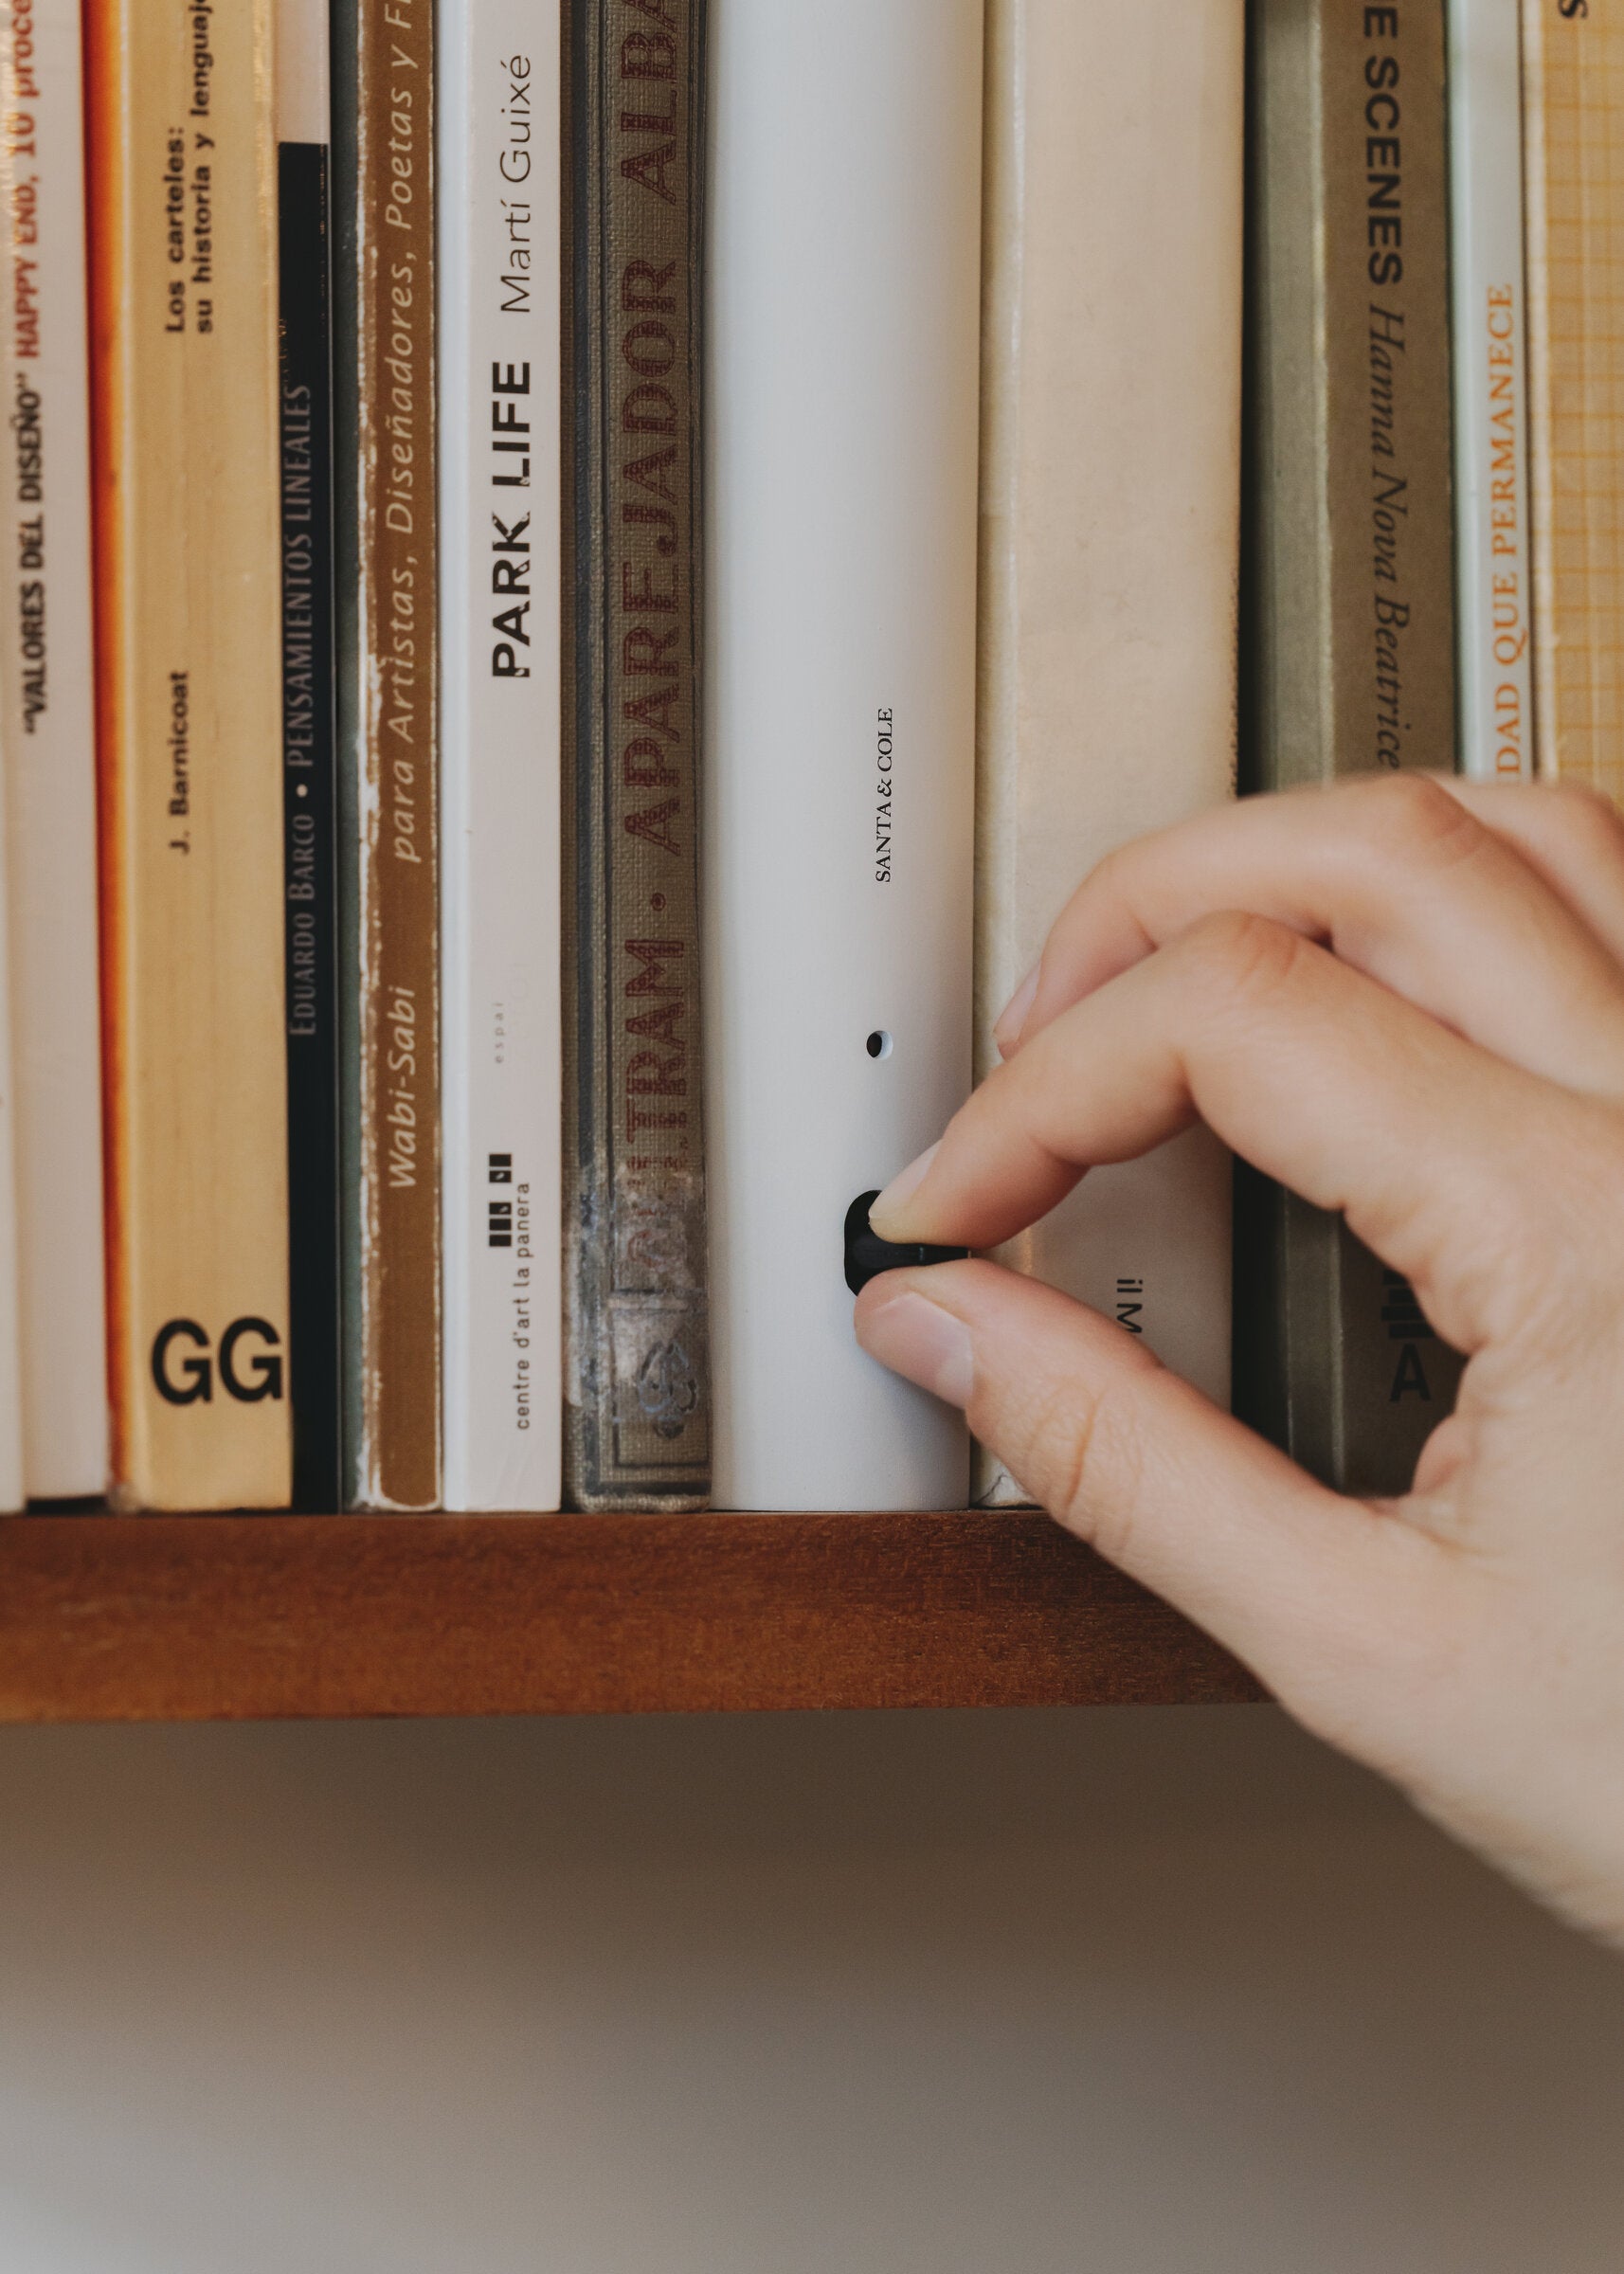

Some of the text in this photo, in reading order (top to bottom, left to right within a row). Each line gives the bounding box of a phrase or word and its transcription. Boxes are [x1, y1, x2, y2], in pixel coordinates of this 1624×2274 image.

[391, 45, 418, 69] y
[13, 175, 40, 244] END,
[163, 127, 185, 333] Los carteles:
[188, 0, 215, 334] su historia y lenguaj
[384, 86, 413, 230] Poetas
[499, 54, 531, 313] Martí Guixé
[1364, 55, 1403, 285] SCENES
[14, 258, 39, 359] HAPPY
[384, 250, 416, 534] Diseñadores,
[283, 384, 311, 521] LINEALES
[1487, 283, 1516, 557] PERMANECE
[18, 515, 44, 569] DEL
[492, 361, 531, 678] PARK LIFE
[622, 260, 680, 857] APAREJADOR
[1369, 302, 1411, 769] Hanna Nova Beatrice
[284, 532, 314, 767] PENSAMIENTOS
[385, 555, 418, 744] Artistas,
[1491, 571, 1528, 666] QUE
[167, 671, 189, 855] J. Barnicoat
[393, 760, 421, 863] para
[875, 708, 893, 882] SANTA & COLE
[387, 985, 416, 1188] Wabi-Sabi
[513, 1267, 530, 1287] la
[516, 1182, 533, 1258] panera
[1116, 1279, 1143, 1292] il
[151, 1315, 283, 1406] GG
[513, 1360, 530, 1430] centre
